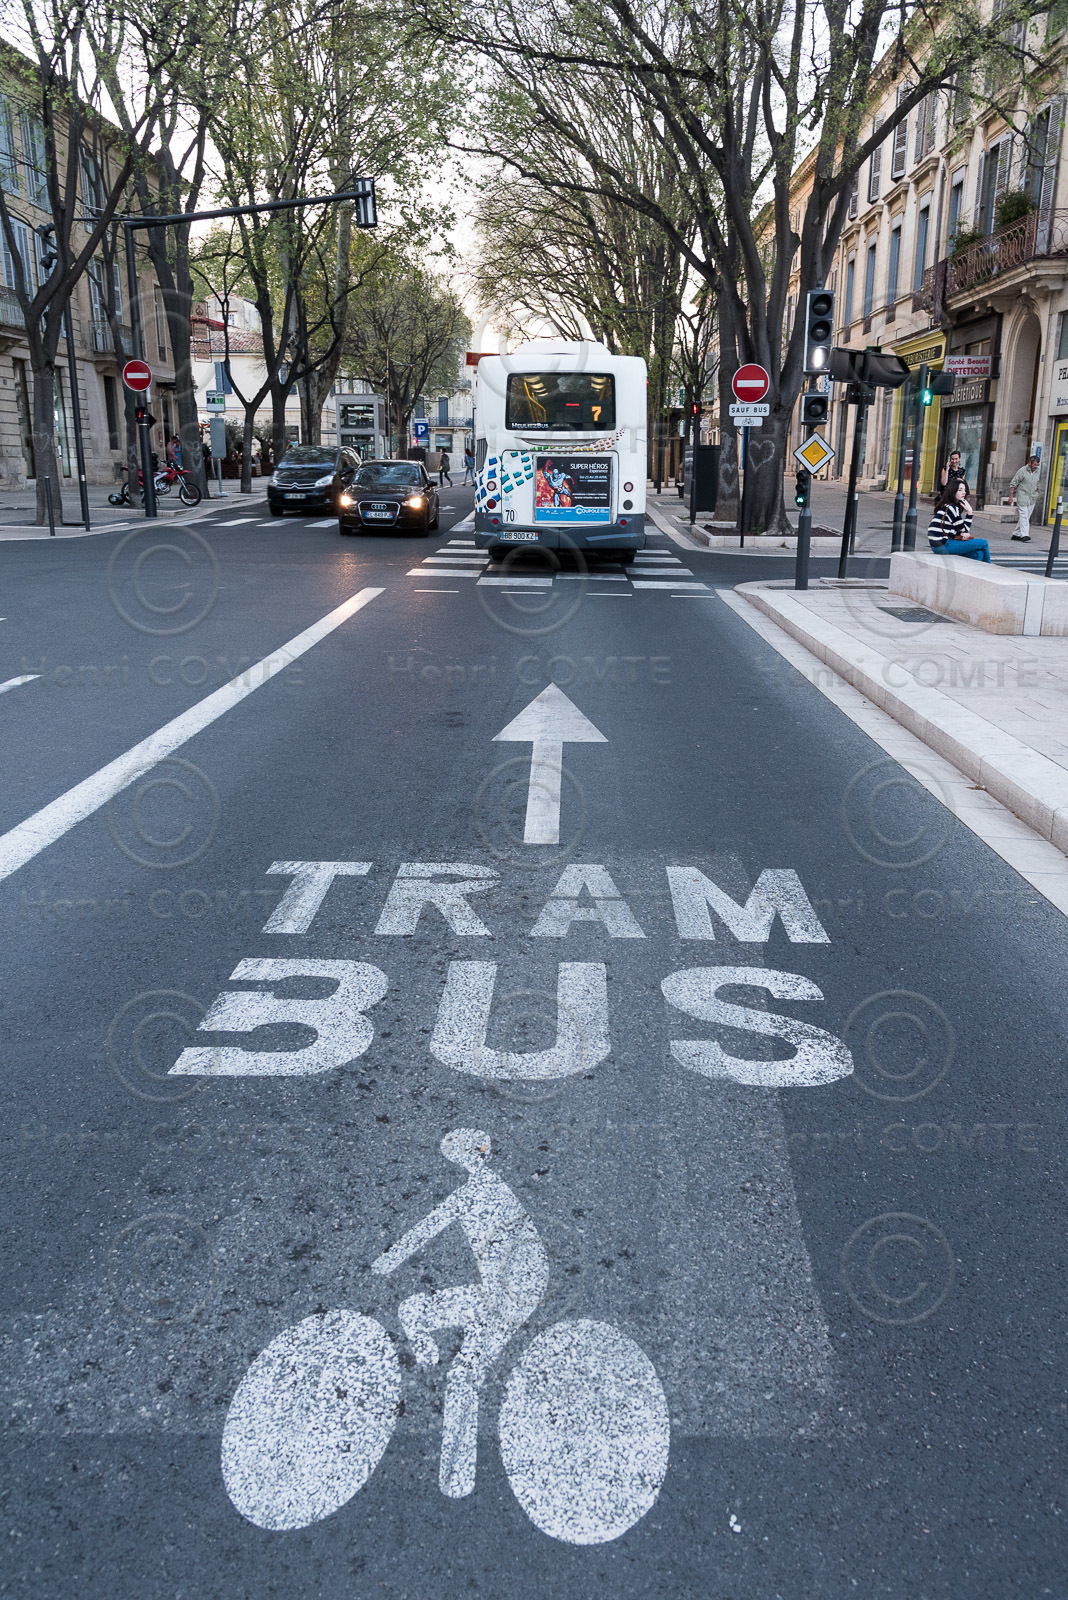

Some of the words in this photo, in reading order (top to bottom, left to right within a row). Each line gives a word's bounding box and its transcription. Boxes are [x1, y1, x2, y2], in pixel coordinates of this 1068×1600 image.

[947, 357, 965, 366] Santé
[967, 356, 990, 366] Beauté
[591, 406, 602, 422] 7
[417, 425, 426, 436] P
[505, 510, 515, 521] 70
[262, 861, 832, 943] TRAM
[167, 958, 855, 1087] BUS
